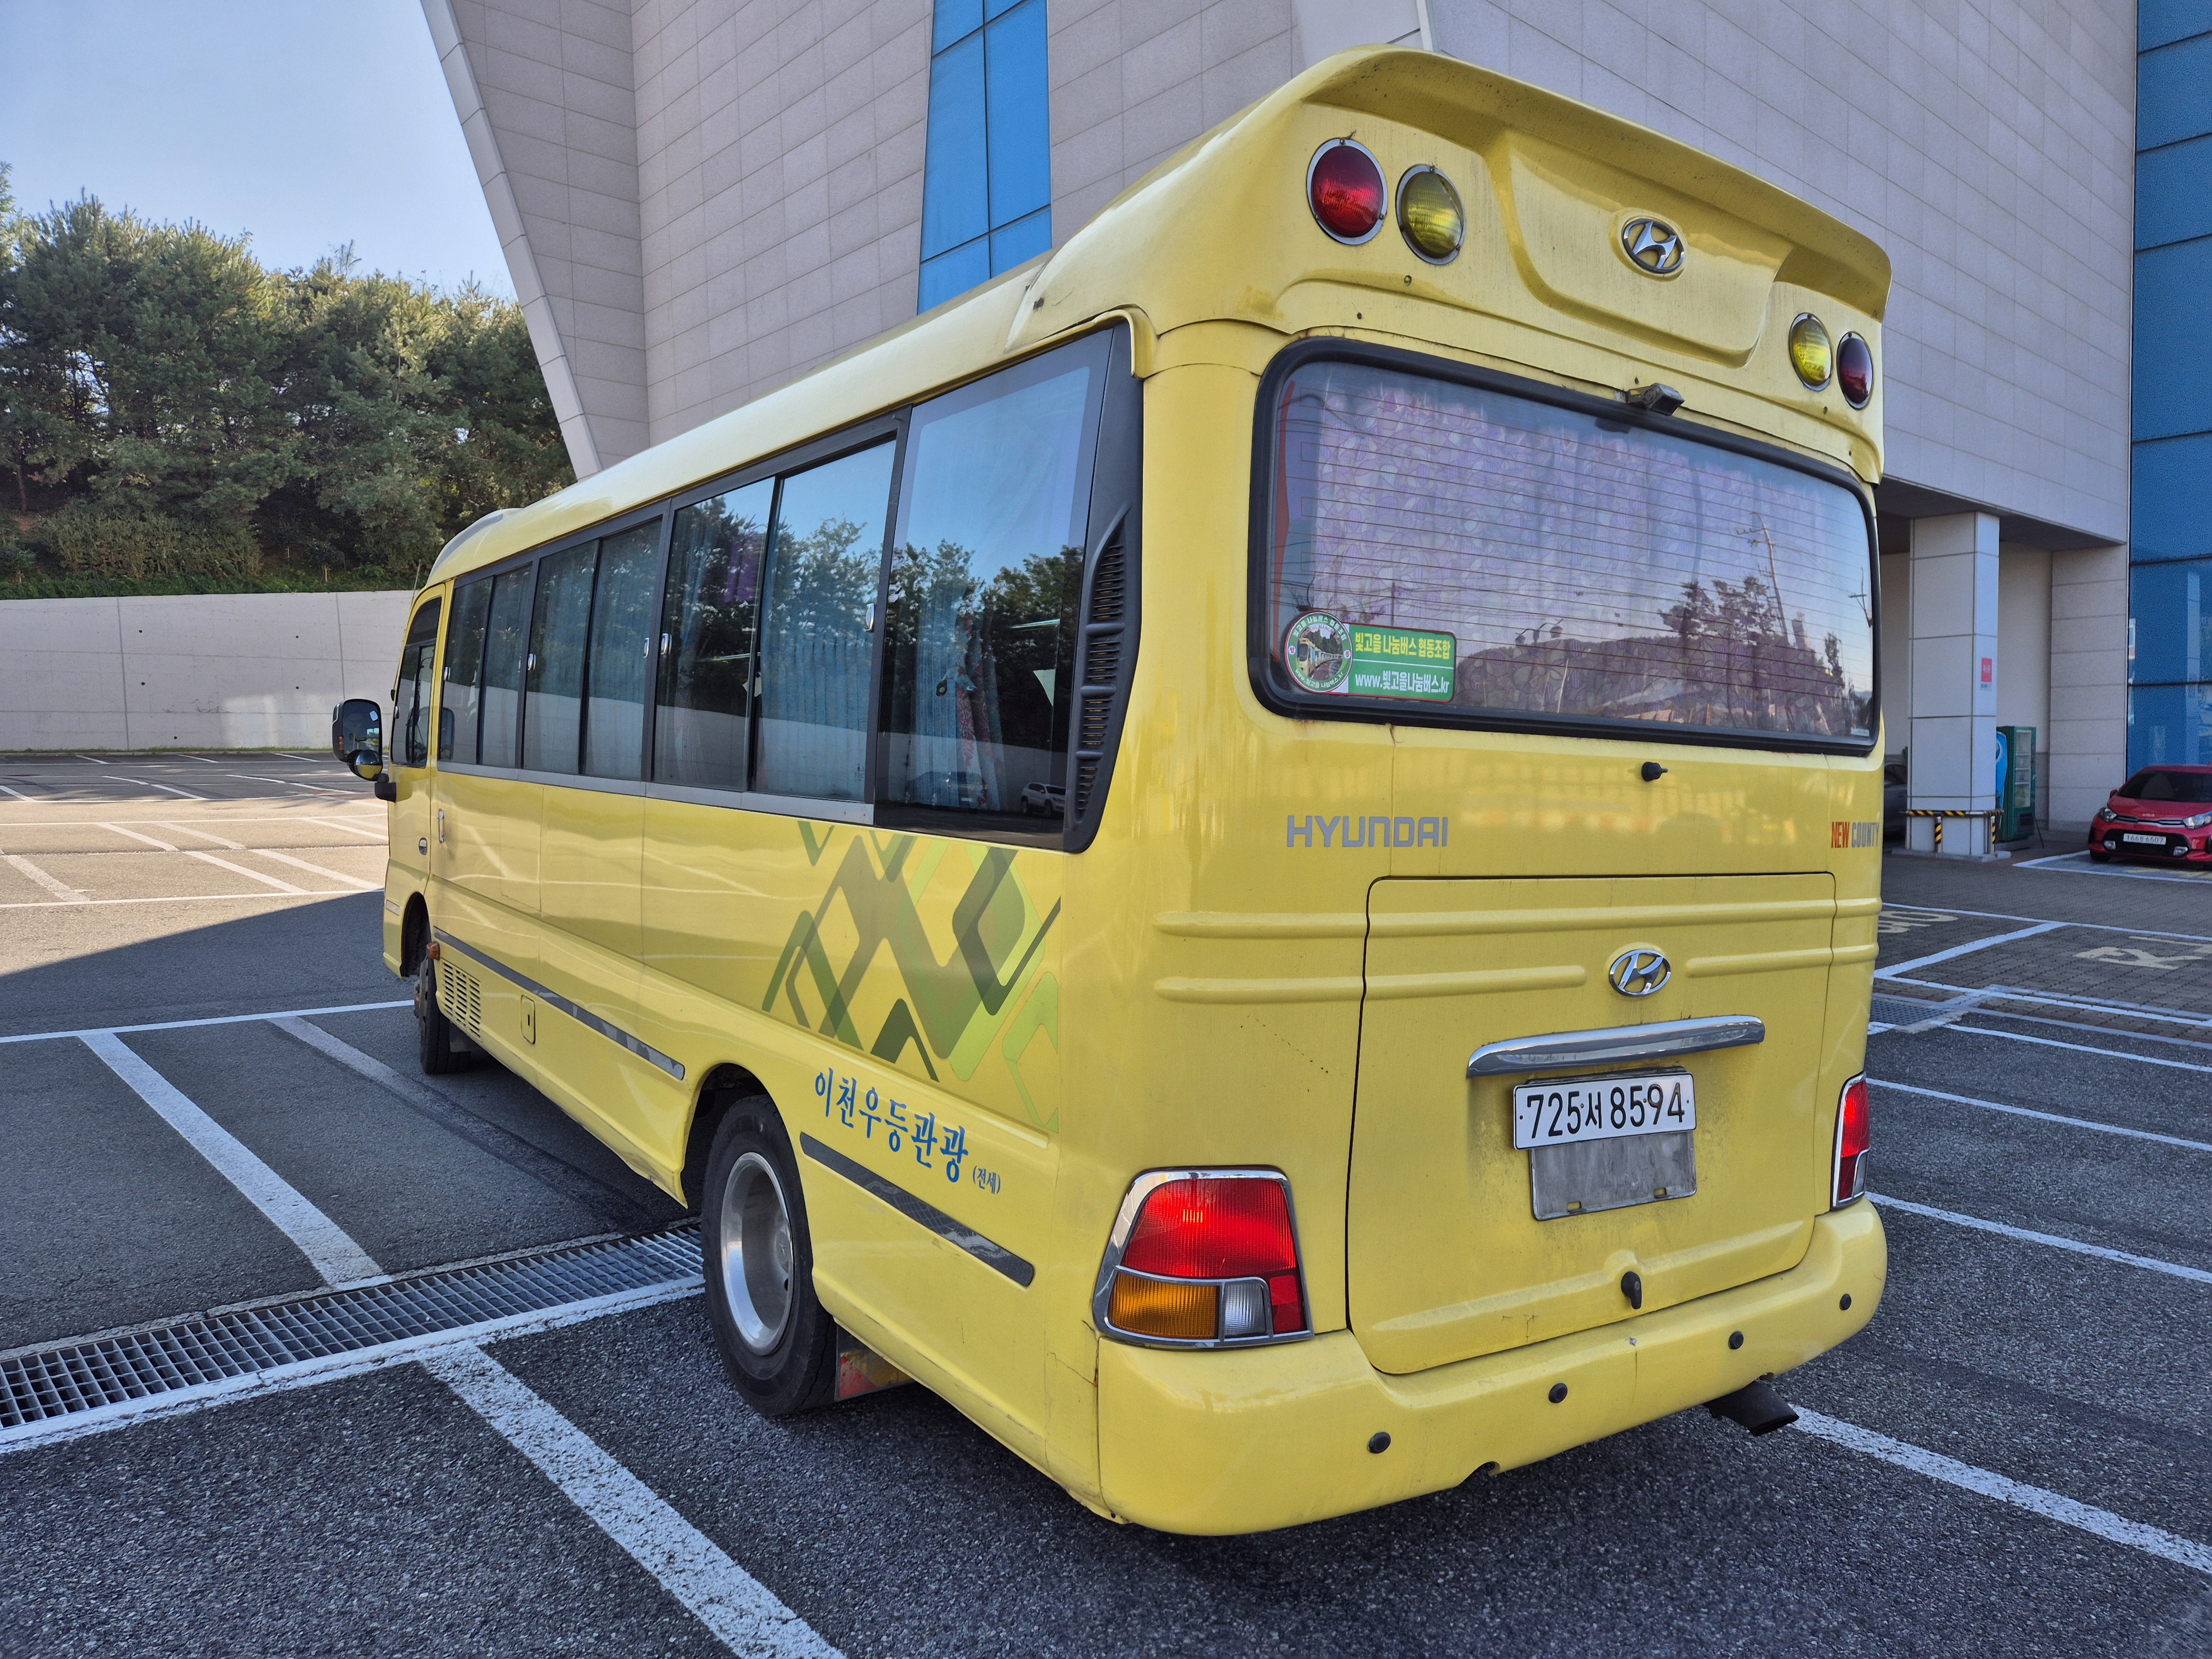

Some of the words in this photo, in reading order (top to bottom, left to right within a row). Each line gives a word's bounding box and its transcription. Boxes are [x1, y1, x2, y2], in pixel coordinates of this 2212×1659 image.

[1355, 632, 1381, 653] 빛고을
[1383, 634, 1417, 656] 나눔버스
[1418, 638, 1451, 659] 협동조합
[1355, 670, 1450, 693] www.빛고을나눔버스.kr
[1287, 815, 1448, 847] HYUNDAI
[1831, 821, 1850, 848] NEW
[1851, 822, 1880, 848] COUNTY
[1527, 1082, 1685, 1139] 725서8594
[815, 1067, 969, 1182] 이천우등관광
[973, 1165, 1001, 1194] (전세)
